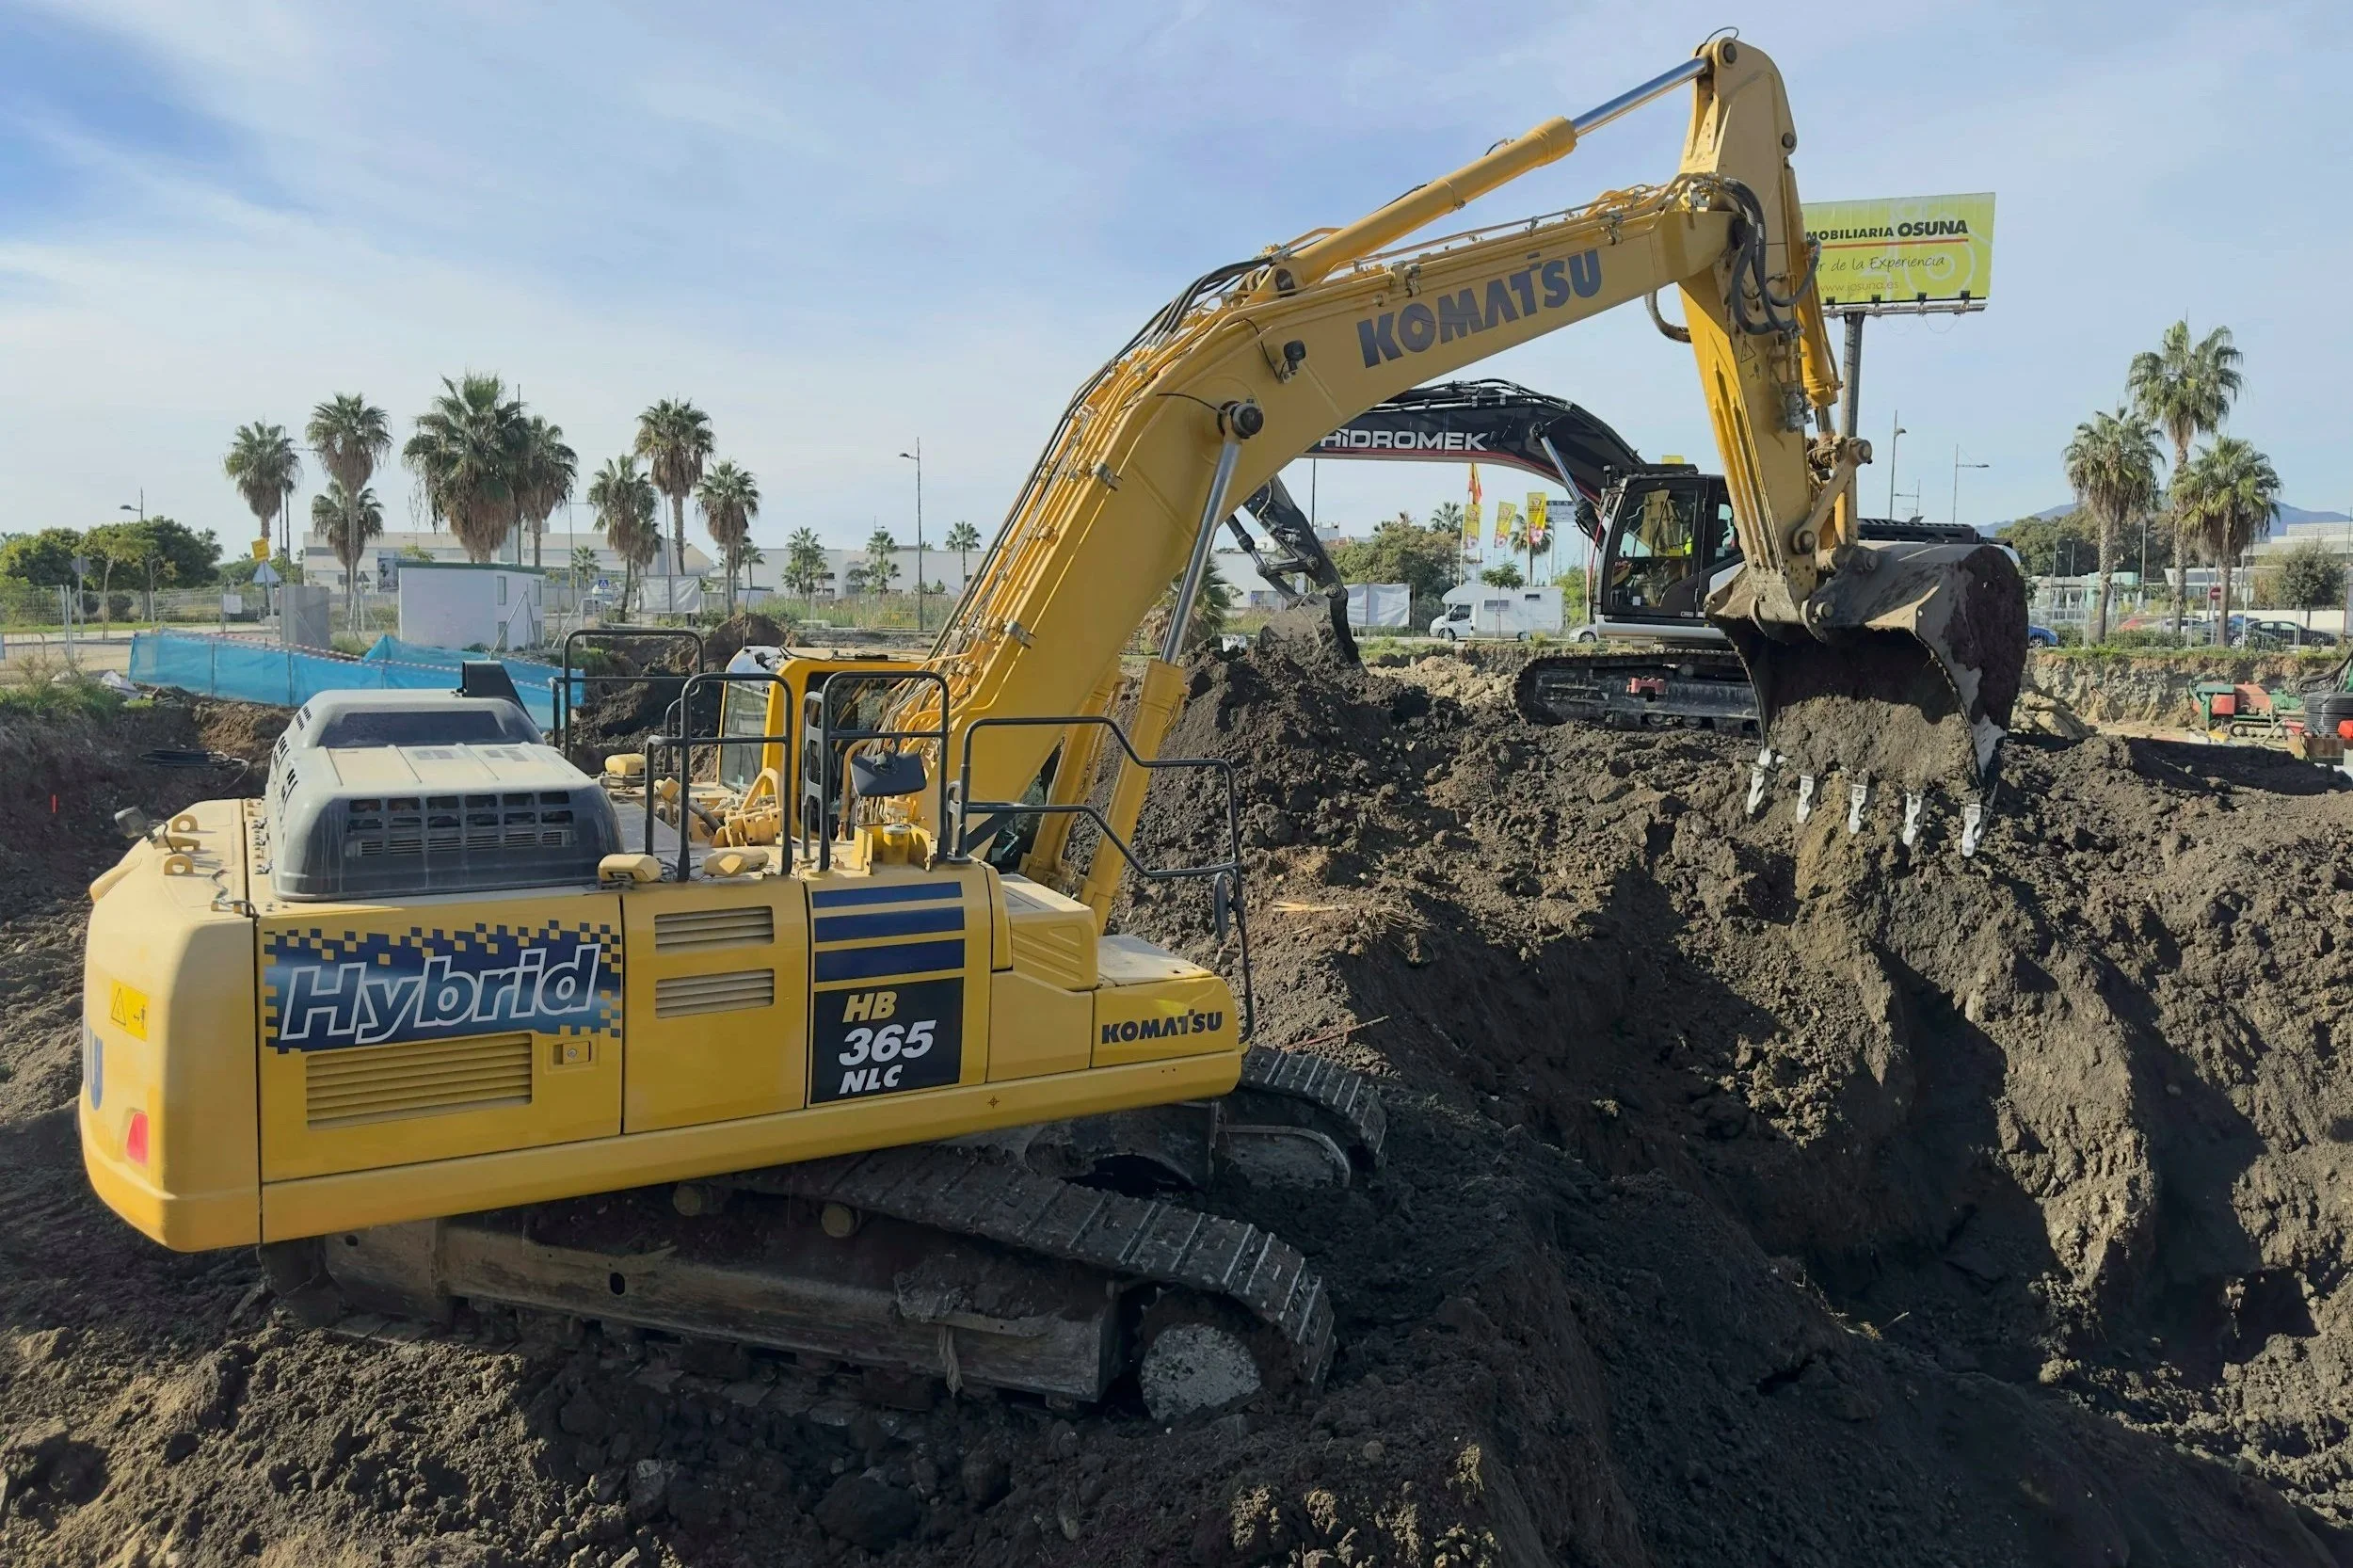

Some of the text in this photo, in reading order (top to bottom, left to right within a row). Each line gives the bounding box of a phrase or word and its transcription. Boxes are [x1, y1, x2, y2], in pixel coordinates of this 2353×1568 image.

[1897, 220, 1968, 237] OSUNA
[1831, 258, 1847, 272] de
[1852, 257, 1865, 271] la
[1870, 256, 1945, 273] Experiencia
[1356, 249, 1602, 368] KOMATSU
[280, 943, 601, 1044] Hybrid
[842, 991, 897, 1023] HB
[839, 1019, 936, 1066] 365
[1101, 1009, 1223, 1044] KOMATSU
[839, 1064, 903, 1095] NLC
